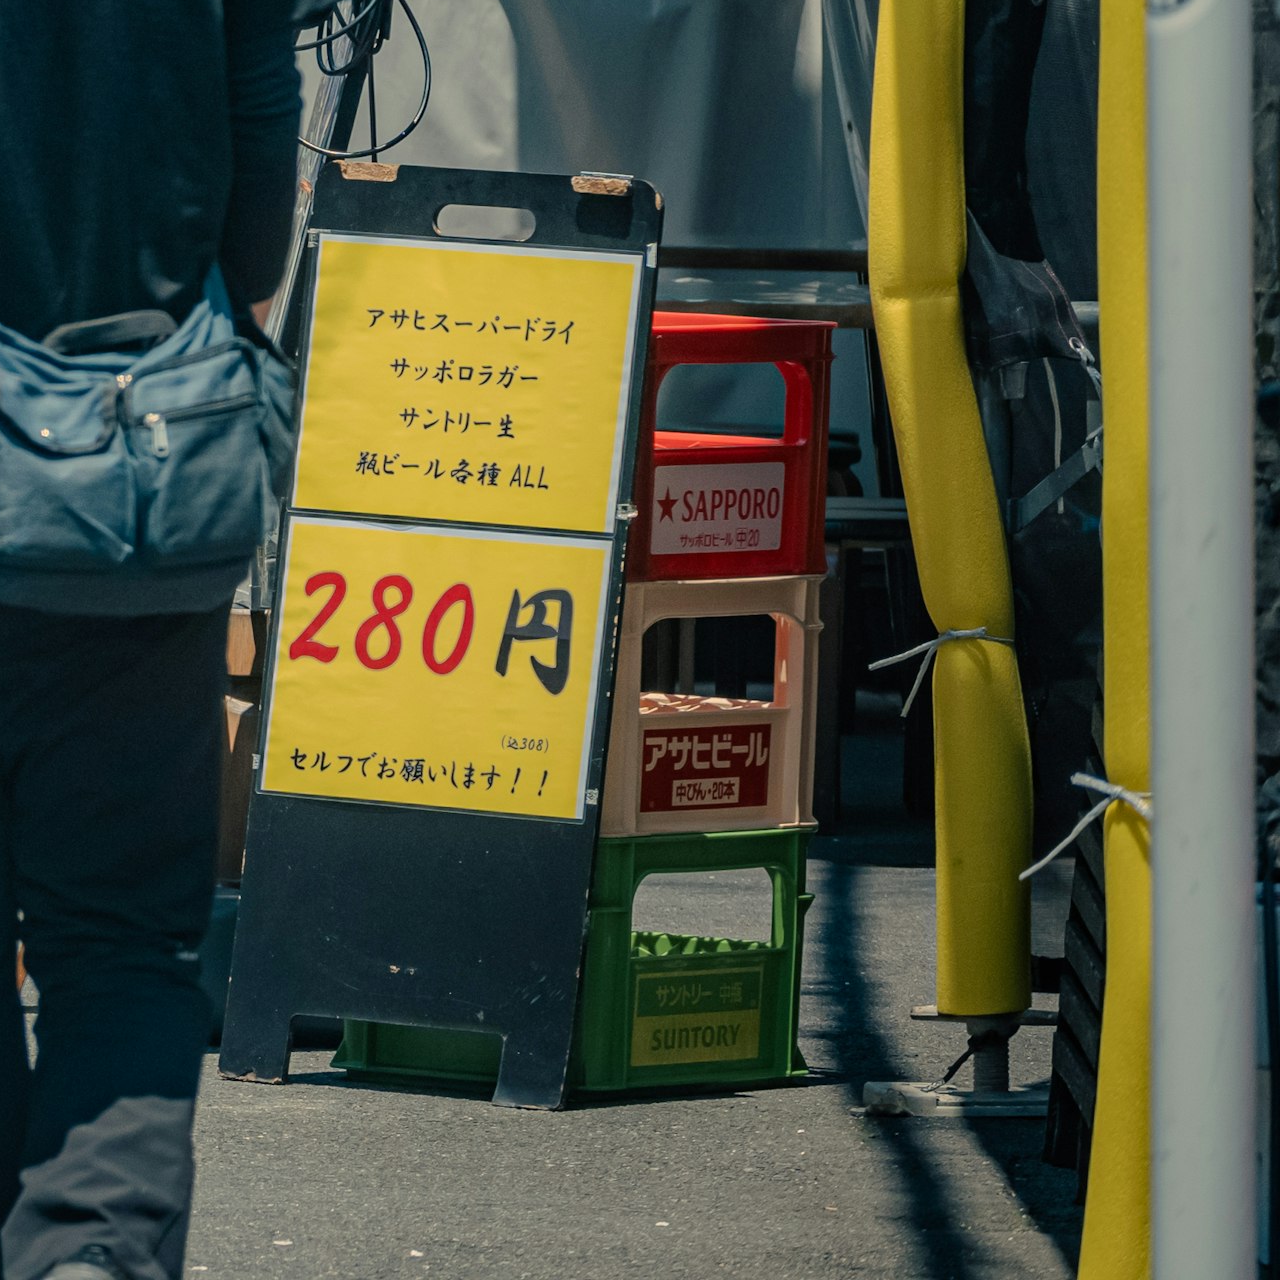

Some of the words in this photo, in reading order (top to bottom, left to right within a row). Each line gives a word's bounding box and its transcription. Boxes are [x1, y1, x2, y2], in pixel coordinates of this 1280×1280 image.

[366, 308, 575, 345] アサヒスーパードライ
[390, 357, 539, 389] サッポロラガー
[509, 464, 550, 490] ALL
[681, 487, 781, 522] SAPPORO
[680, 533, 733, 548] サッポロビール
[501, 734, 549, 754] (込308)
[645, 732, 769, 772] アサヒビール
[675, 780, 736, 803] 中びん・20本
[655, 983, 713, 1008] サントリー
